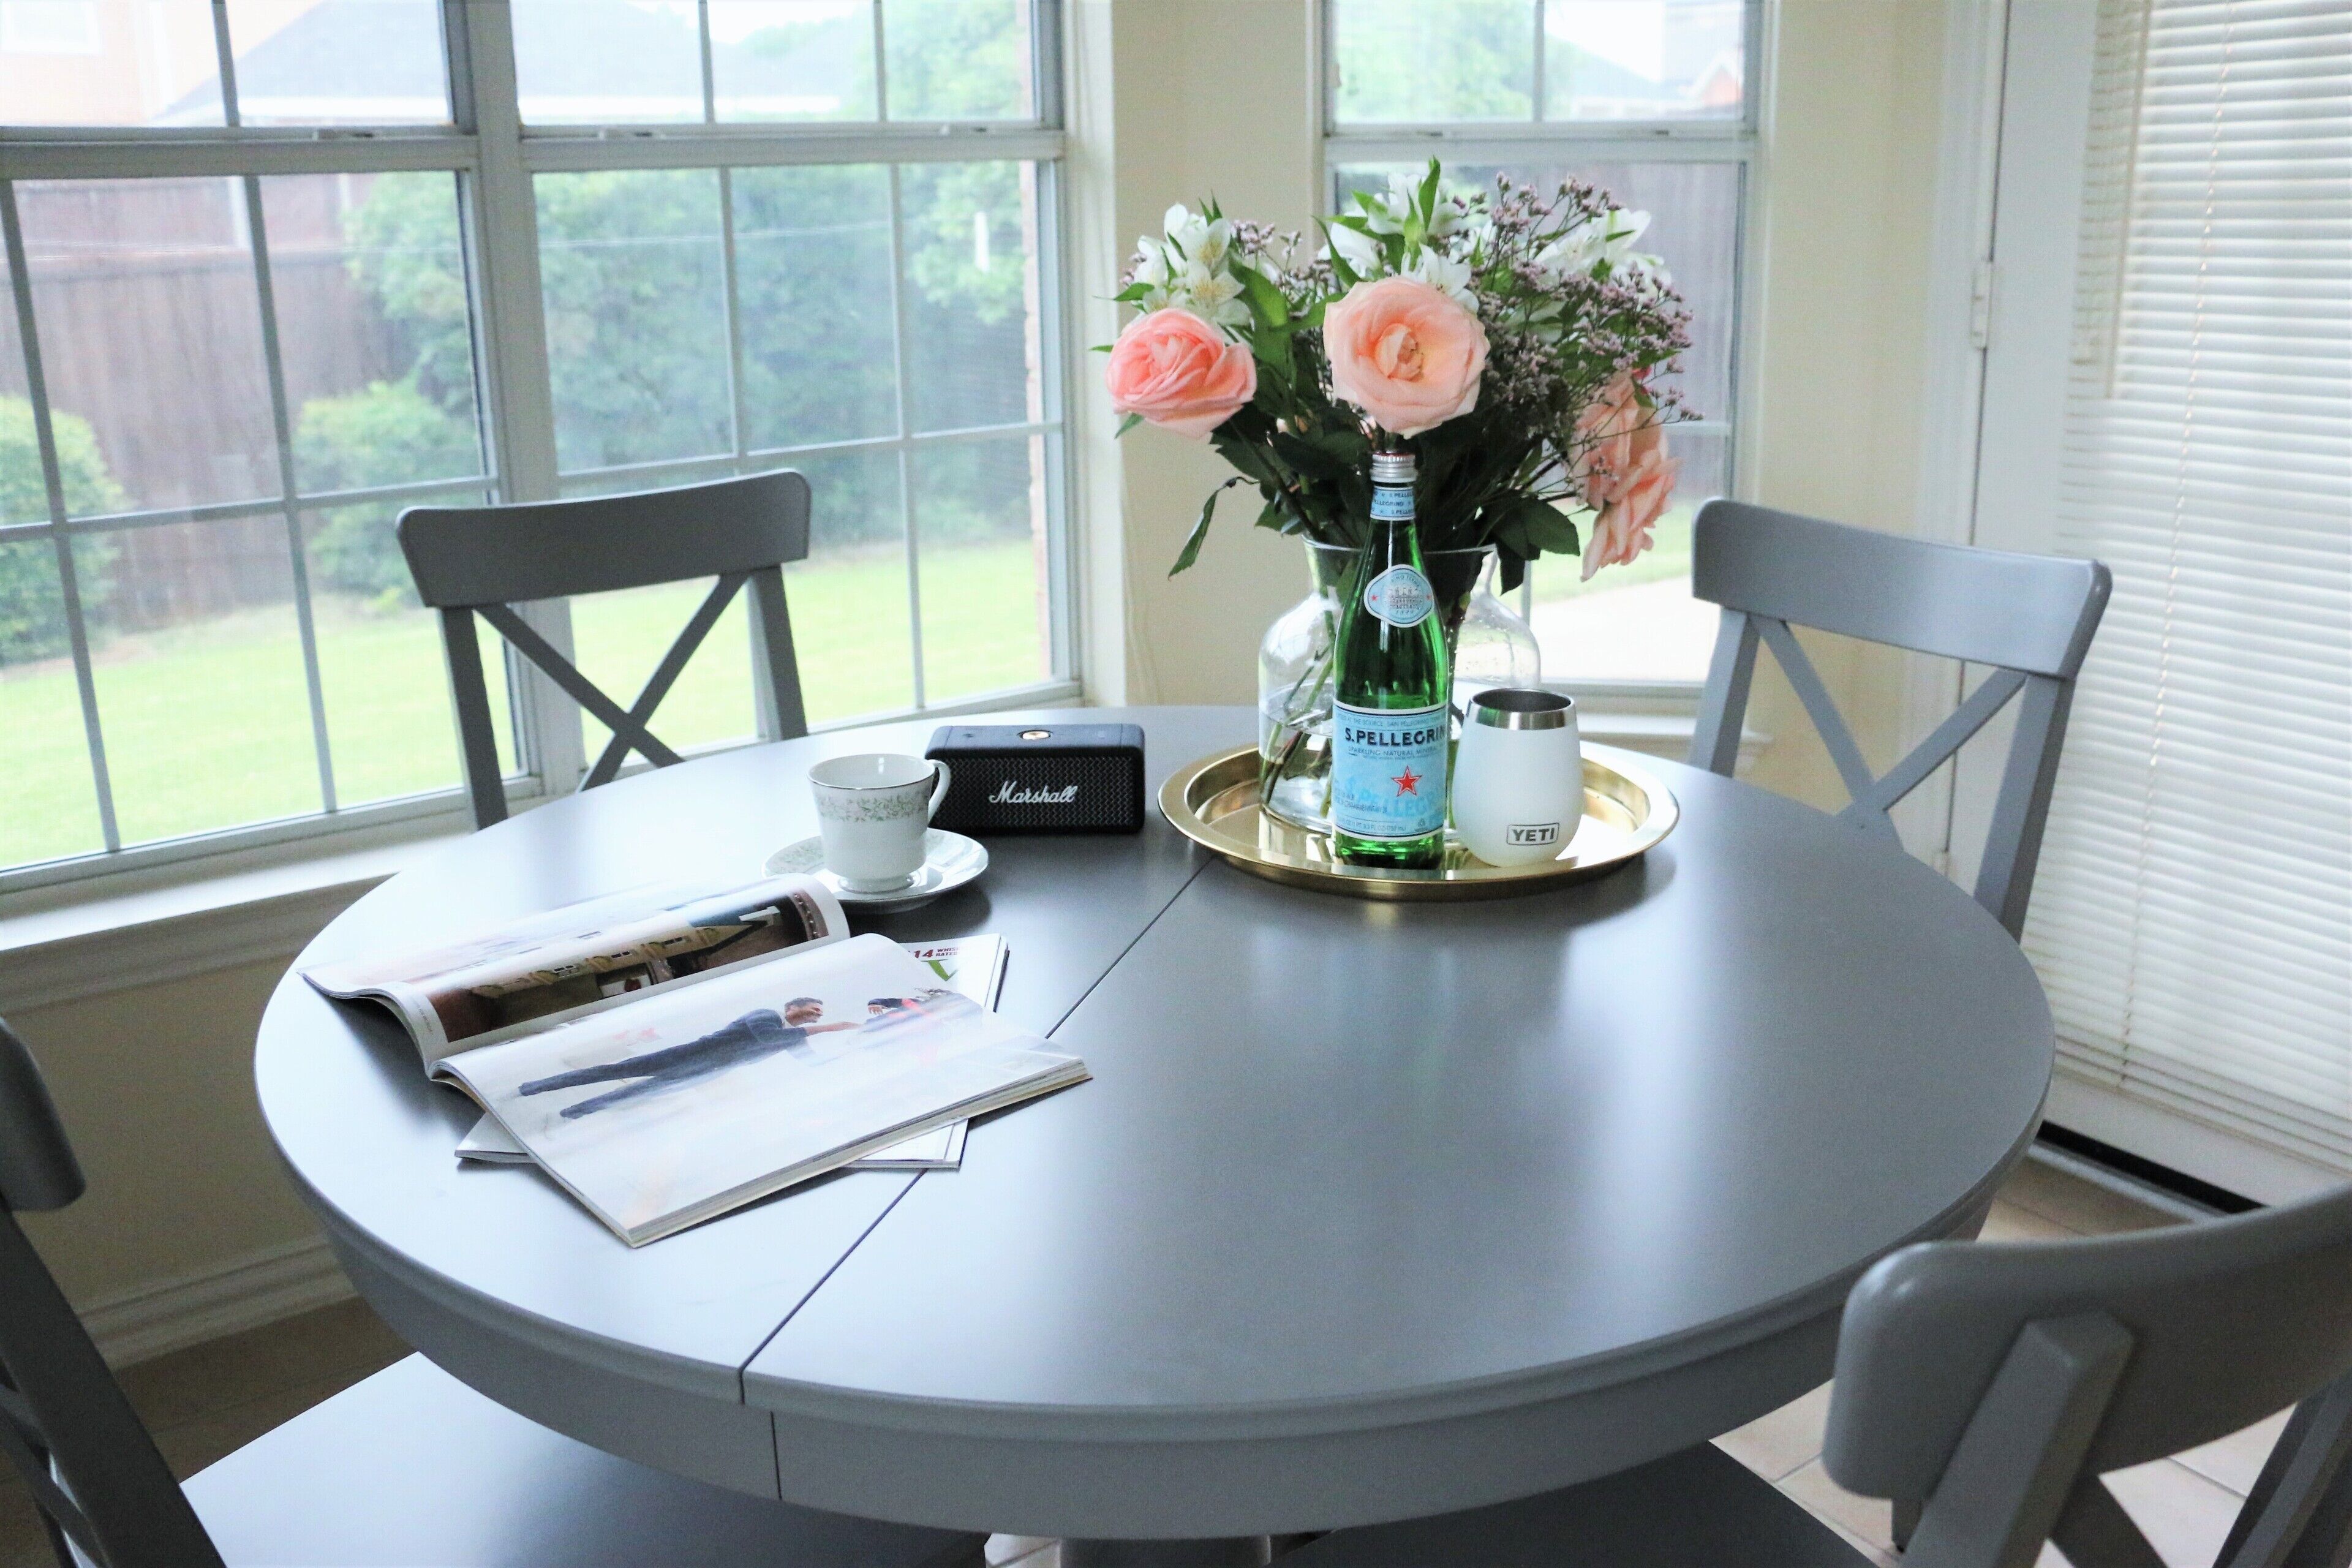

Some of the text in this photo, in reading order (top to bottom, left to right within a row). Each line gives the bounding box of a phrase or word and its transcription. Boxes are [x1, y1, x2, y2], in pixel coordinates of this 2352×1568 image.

[1349, 745, 1381, 756] SPARKLING
[989, 780, 1079, 804] Marshall
[1511, 827, 1555, 842] YETI
[914, 949, 933, 959] 14
